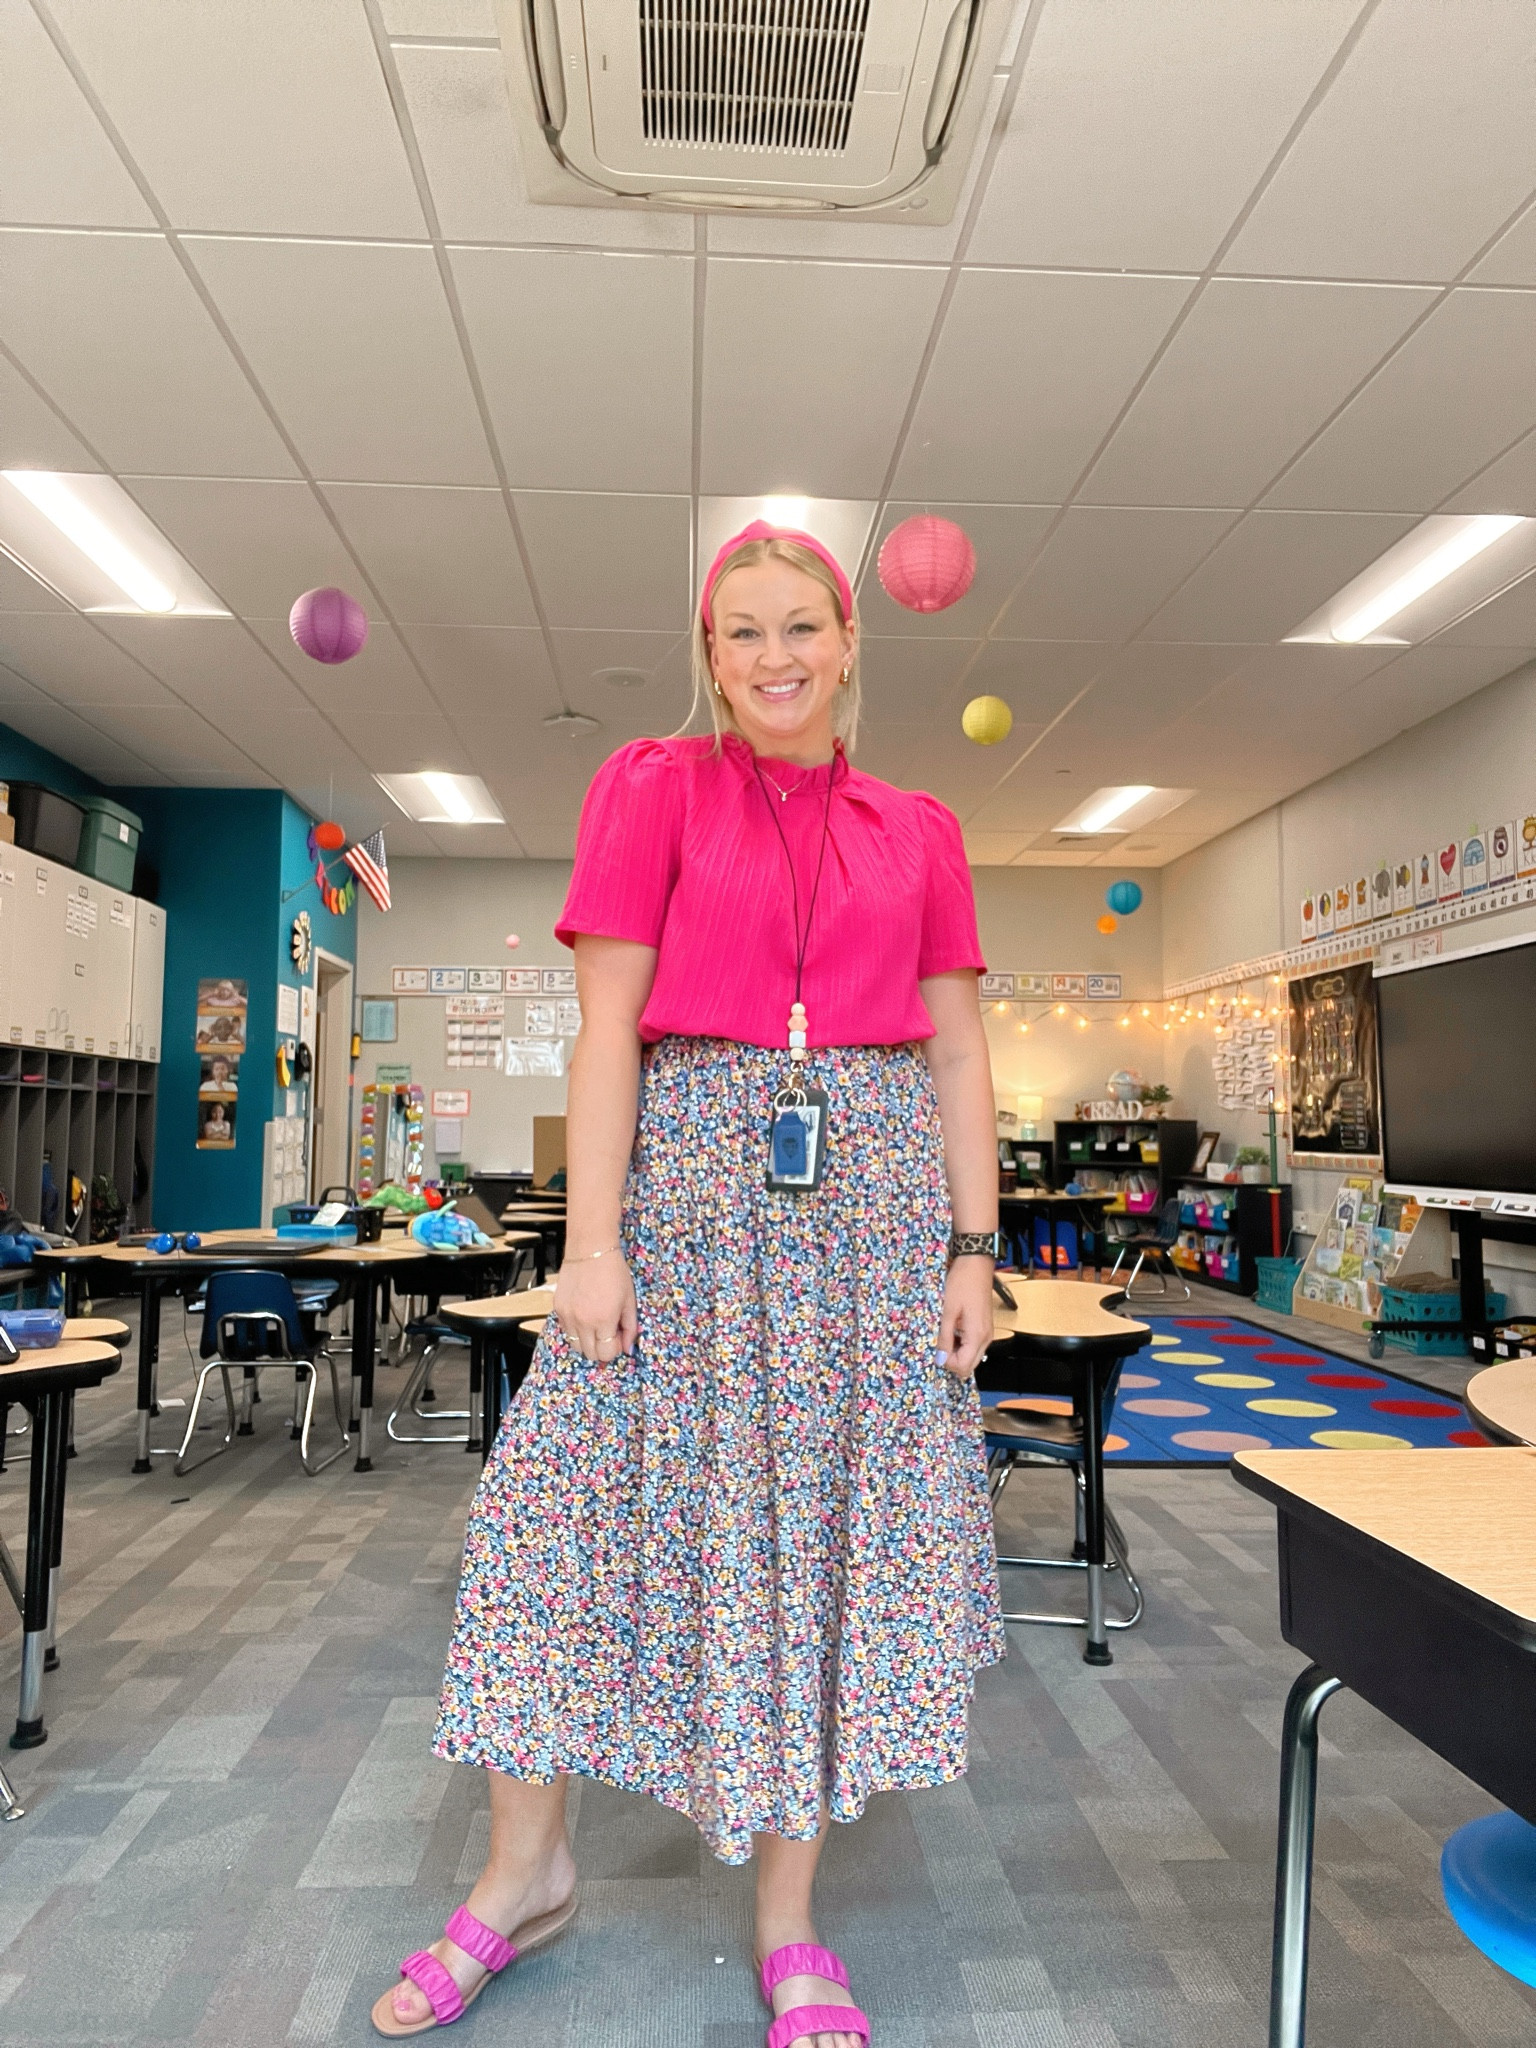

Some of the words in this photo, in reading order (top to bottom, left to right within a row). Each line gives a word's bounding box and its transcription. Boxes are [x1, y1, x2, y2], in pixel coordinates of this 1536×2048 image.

[436, 972, 443, 982] 2
[473, 972, 481, 982] 3
[510, 973, 517, 982] 4
[547, 973, 555, 983] 5
[985, 977, 995, 987] 17
[1090, 978, 1103, 988] 20
[1090, 1100, 1144, 1120] READ
